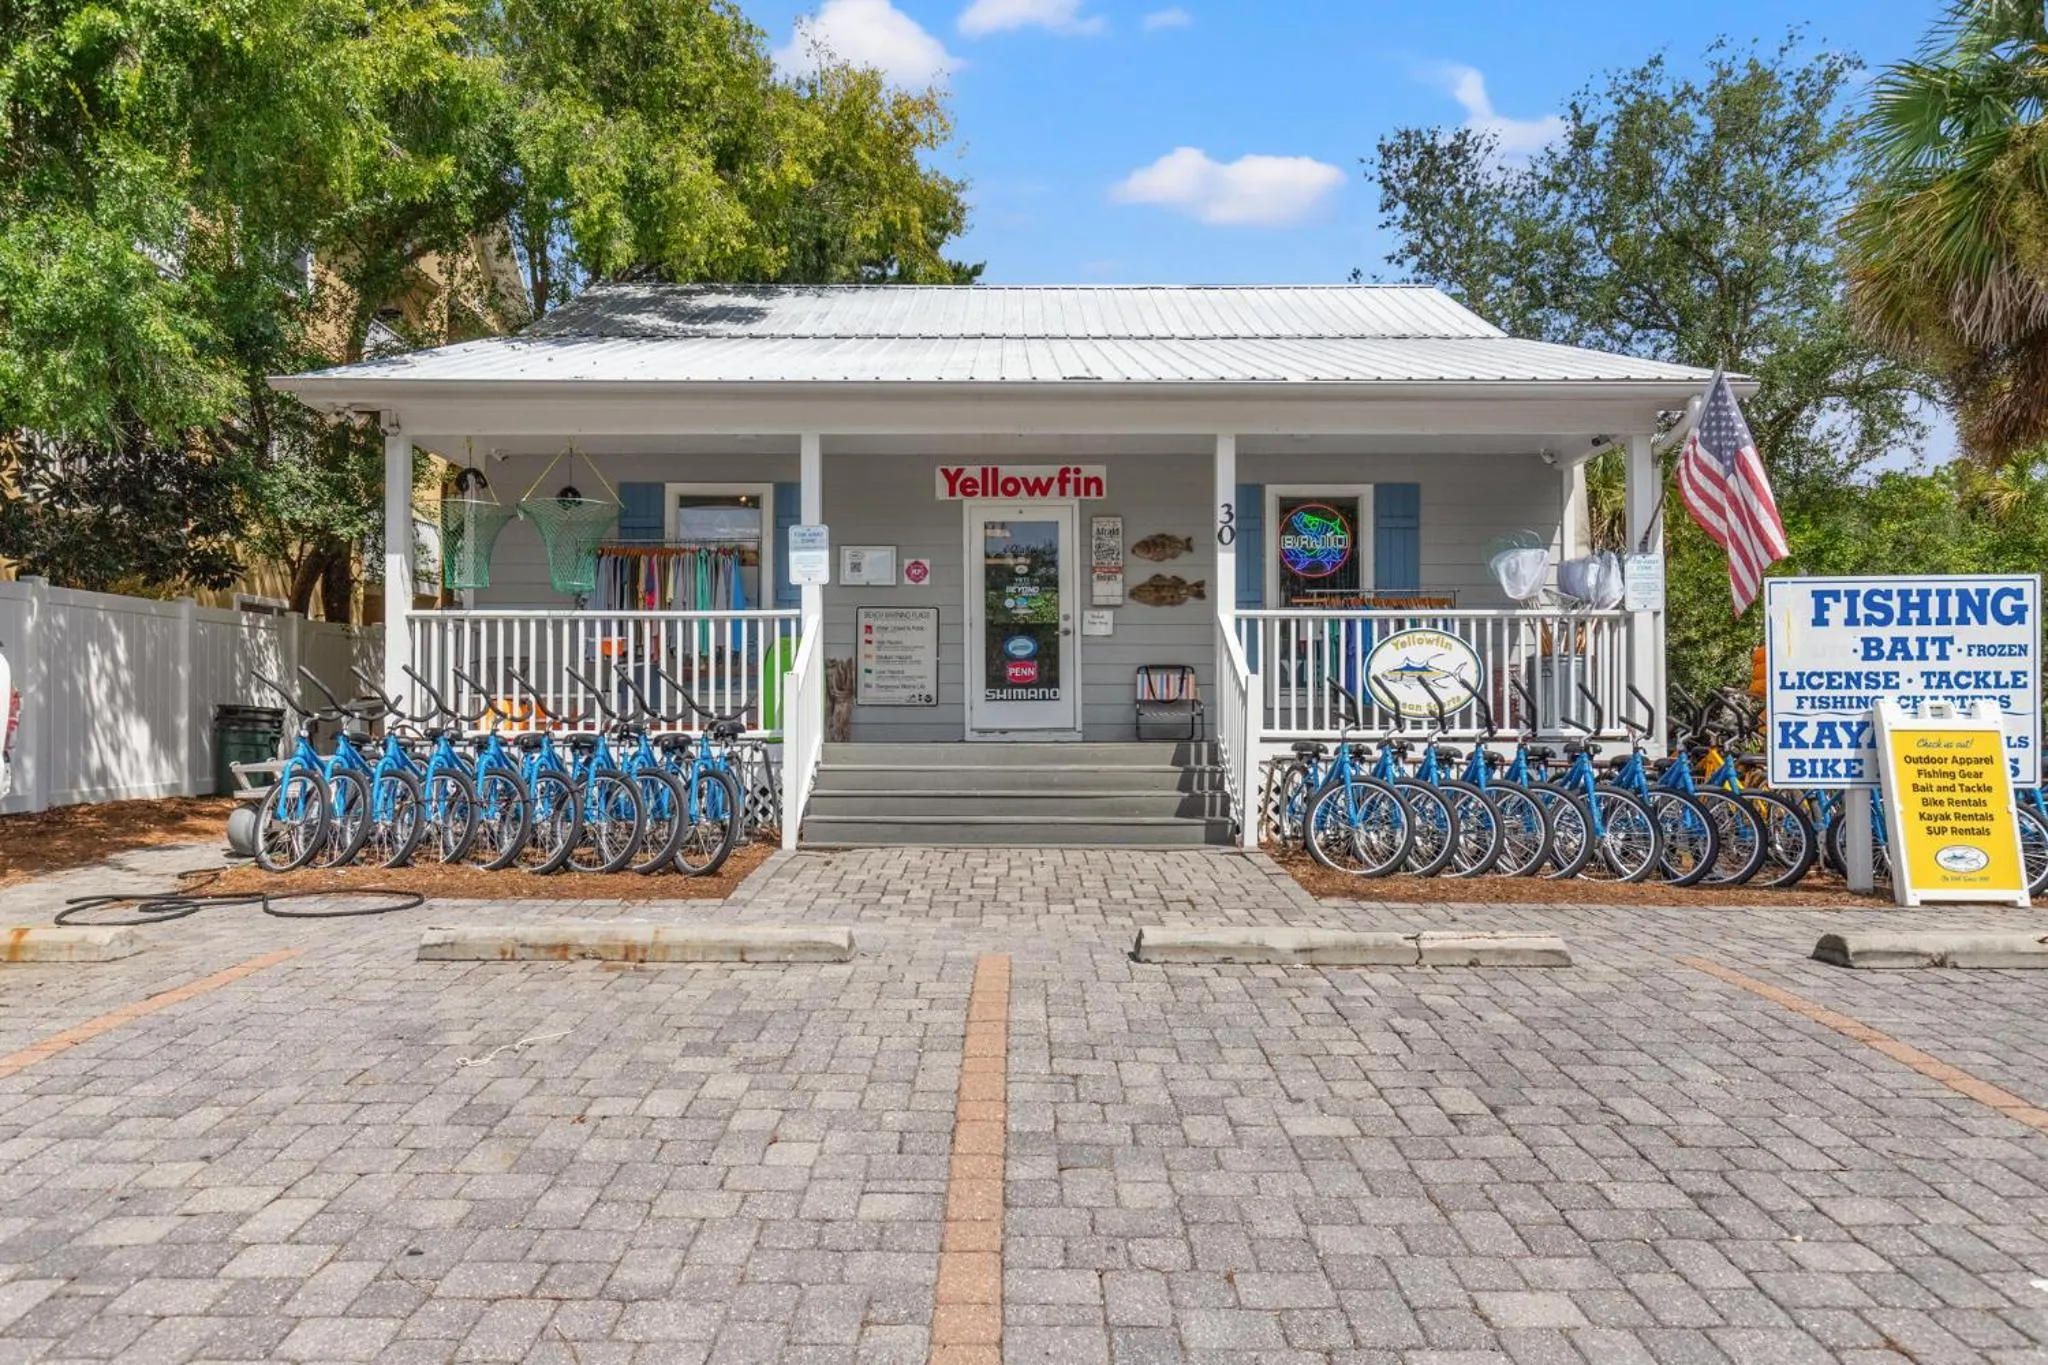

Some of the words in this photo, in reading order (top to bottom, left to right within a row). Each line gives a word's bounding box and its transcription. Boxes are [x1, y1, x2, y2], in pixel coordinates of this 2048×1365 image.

[940, 467, 1103, 497] Yellowfin
[1811, 587, 2028, 627] FISHING
[1391, 635, 1453, 651] Yellowfin
[1861, 635, 1954, 661] BAIT
[1967, 644, 2028, 657] FROZEN
[1008, 667, 1035, 677] PENN
[1779, 671, 1900, 690] LICENSE
[1920, 671, 2028, 690] TACKLE
[986, 687, 1060, 700] SHIMANO
[1916, 737, 1942, 748] Check
[1904, 755, 1948, 765] Outdoor
[1951, 755, 1994, 766] Apparel
[1788, 758, 1864, 778] BIKE
[1917, 769, 1956, 780] Fishing
[1958, 769, 1983, 778] Gear
[1912, 783, 1933, 792] Bait
[1936, 783, 1956, 792] and
[1958, 783, 1993, 793] Tackle
[1921, 797, 1945, 807] Bike
[1947, 798, 1988, 807] Rentals
[1918, 811, 1952, 822] Kayak
[1953, 812, 1994, 821] Rentals
[1926, 826, 1948, 836] SUP
[1950, 826, 1991, 836] Rentals
